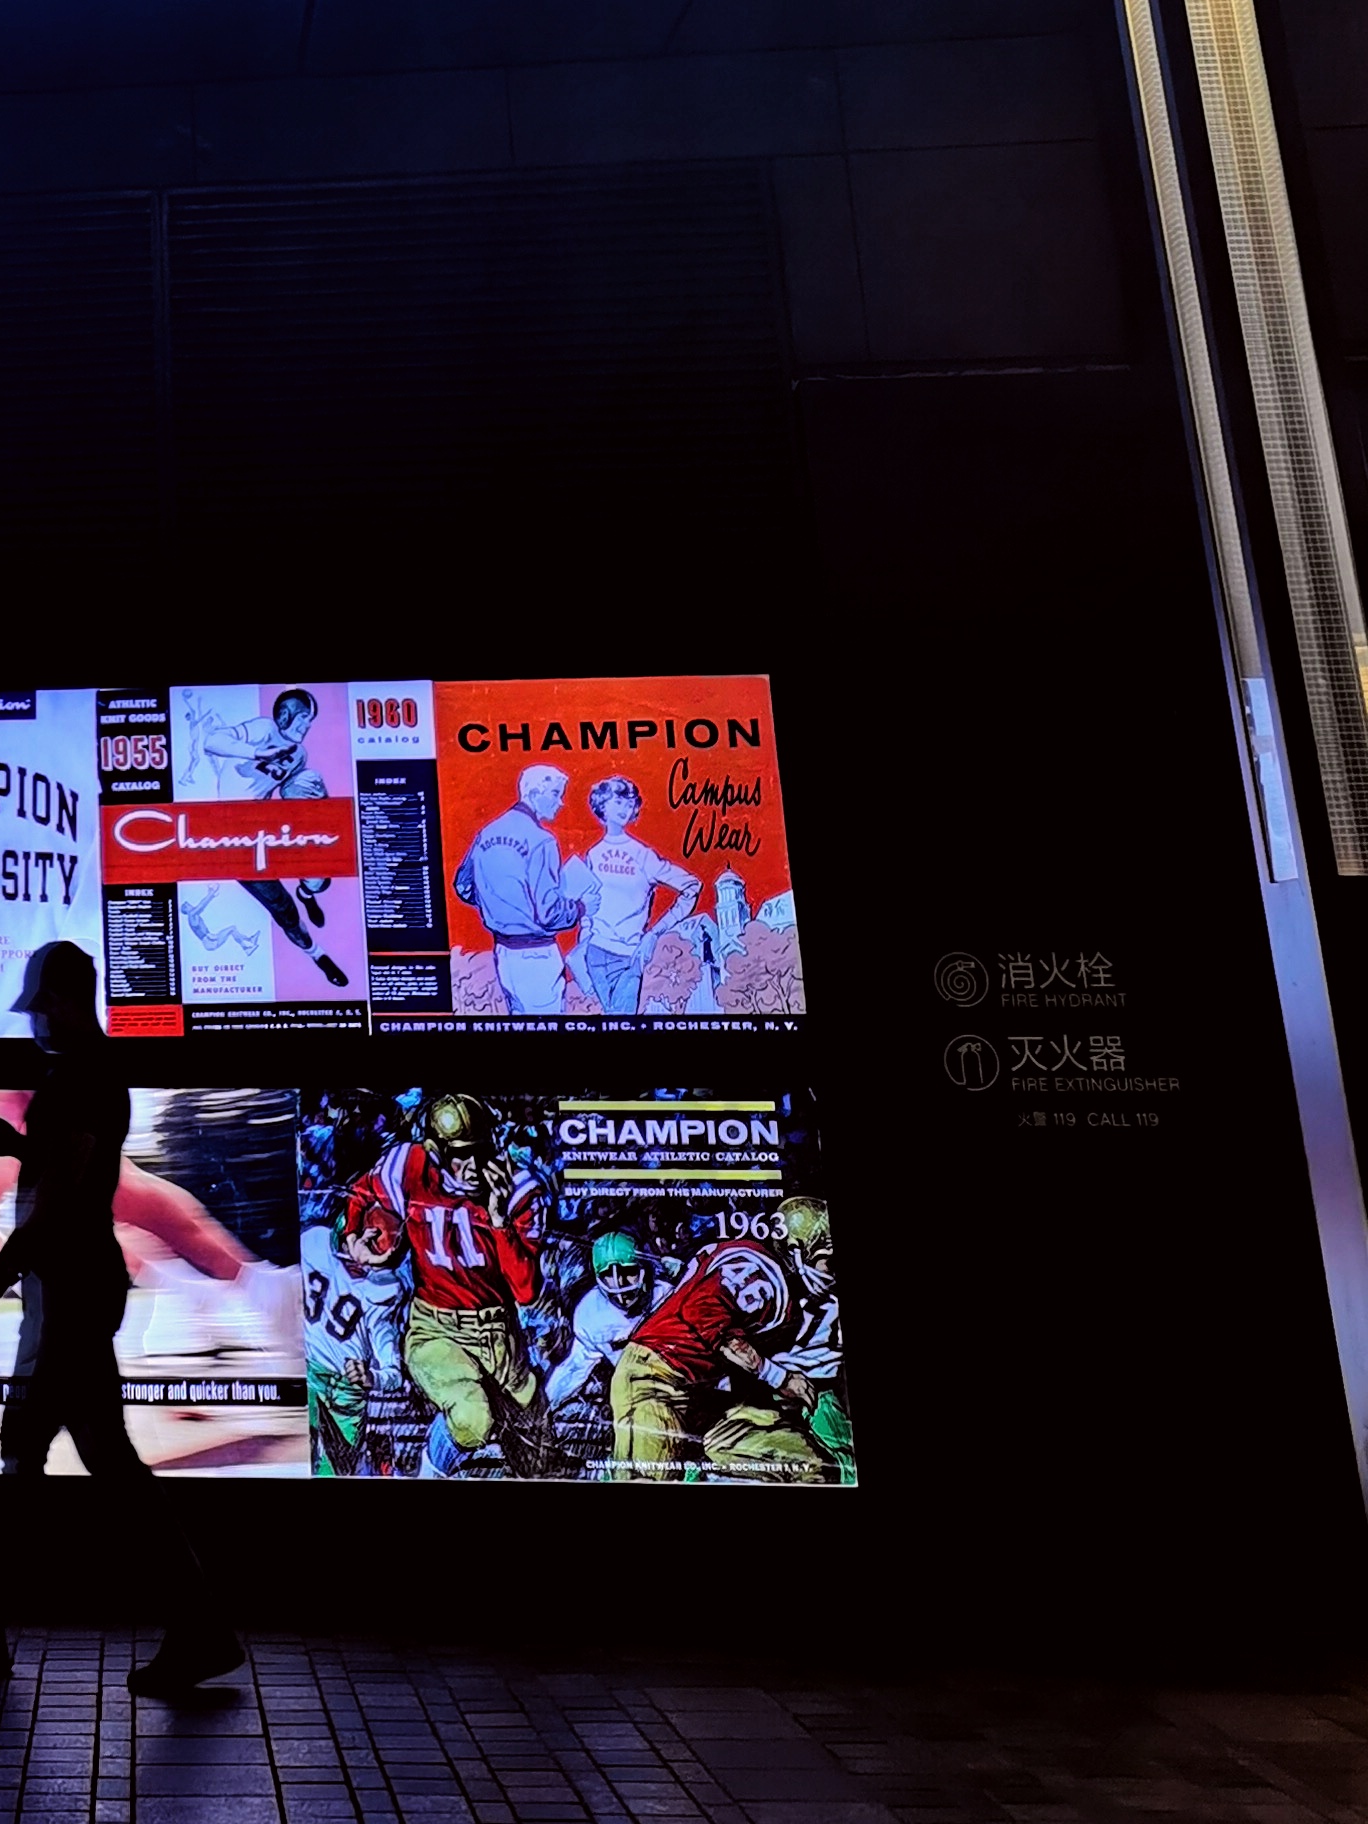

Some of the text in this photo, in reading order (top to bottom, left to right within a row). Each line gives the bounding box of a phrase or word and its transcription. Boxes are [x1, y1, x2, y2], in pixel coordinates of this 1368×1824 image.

[108, 699, 157, 709] ATHLETIC
[101, 712, 166, 724] KNIT GOODS
[355, 697, 419, 728] 1960
[357, 734, 420, 745] catalog
[457, 718, 762, 753] CHAMPION
[100, 734, 168, 772] 1955
[111, 781, 161, 792] CATALOG
[668, 756, 762, 816] Campus
[112, 808, 341, 872] Champion
[683, 809, 762, 858] Wear
[597, 861, 636, 876] COLLEGE
[191, 964, 209, 973] BUY
[997, 951, 1116, 989] 消火栓
[191, 975, 237, 983] FROM THE
[192, 986, 263, 994] MANUFACTURER
[1001, 992, 1127, 1008] FIRE HYDRANT
[379, 1022, 467, 1033] CHAMPION
[472, 1021, 559, 1031] KNITWEAR
[601, 1020, 635, 1031] INC.
[653, 1020, 758, 1032] ROCHESTER,
[1007, 1034, 1126, 1072] 灭火器
[1011, 1077, 1181, 1092] FIRE EXTINGUISHER
[1053, 1112, 1077, 1127] 119
[1087, 1112, 1132, 1127] CALL
[1136, 1112, 1160, 1127] 119
[558, 1119, 780, 1146] CHAMPION
[562, 1150, 780, 1163] KNITWEAR ATHLETIC CATALOG
[564, 1187, 784, 1198] BUY DIRECT FROM THE MANUFACTURER
[714, 1211, 789, 1241] 1963
[422, 1203, 487, 1272] 11
[121, 1381, 165, 1404] stronger
[168, 1381, 187, 1402] and
[189, 1381, 229, 1404] quicker
[231, 1382, 256, 1402] than
[257, 1383, 282, 1404] you.
